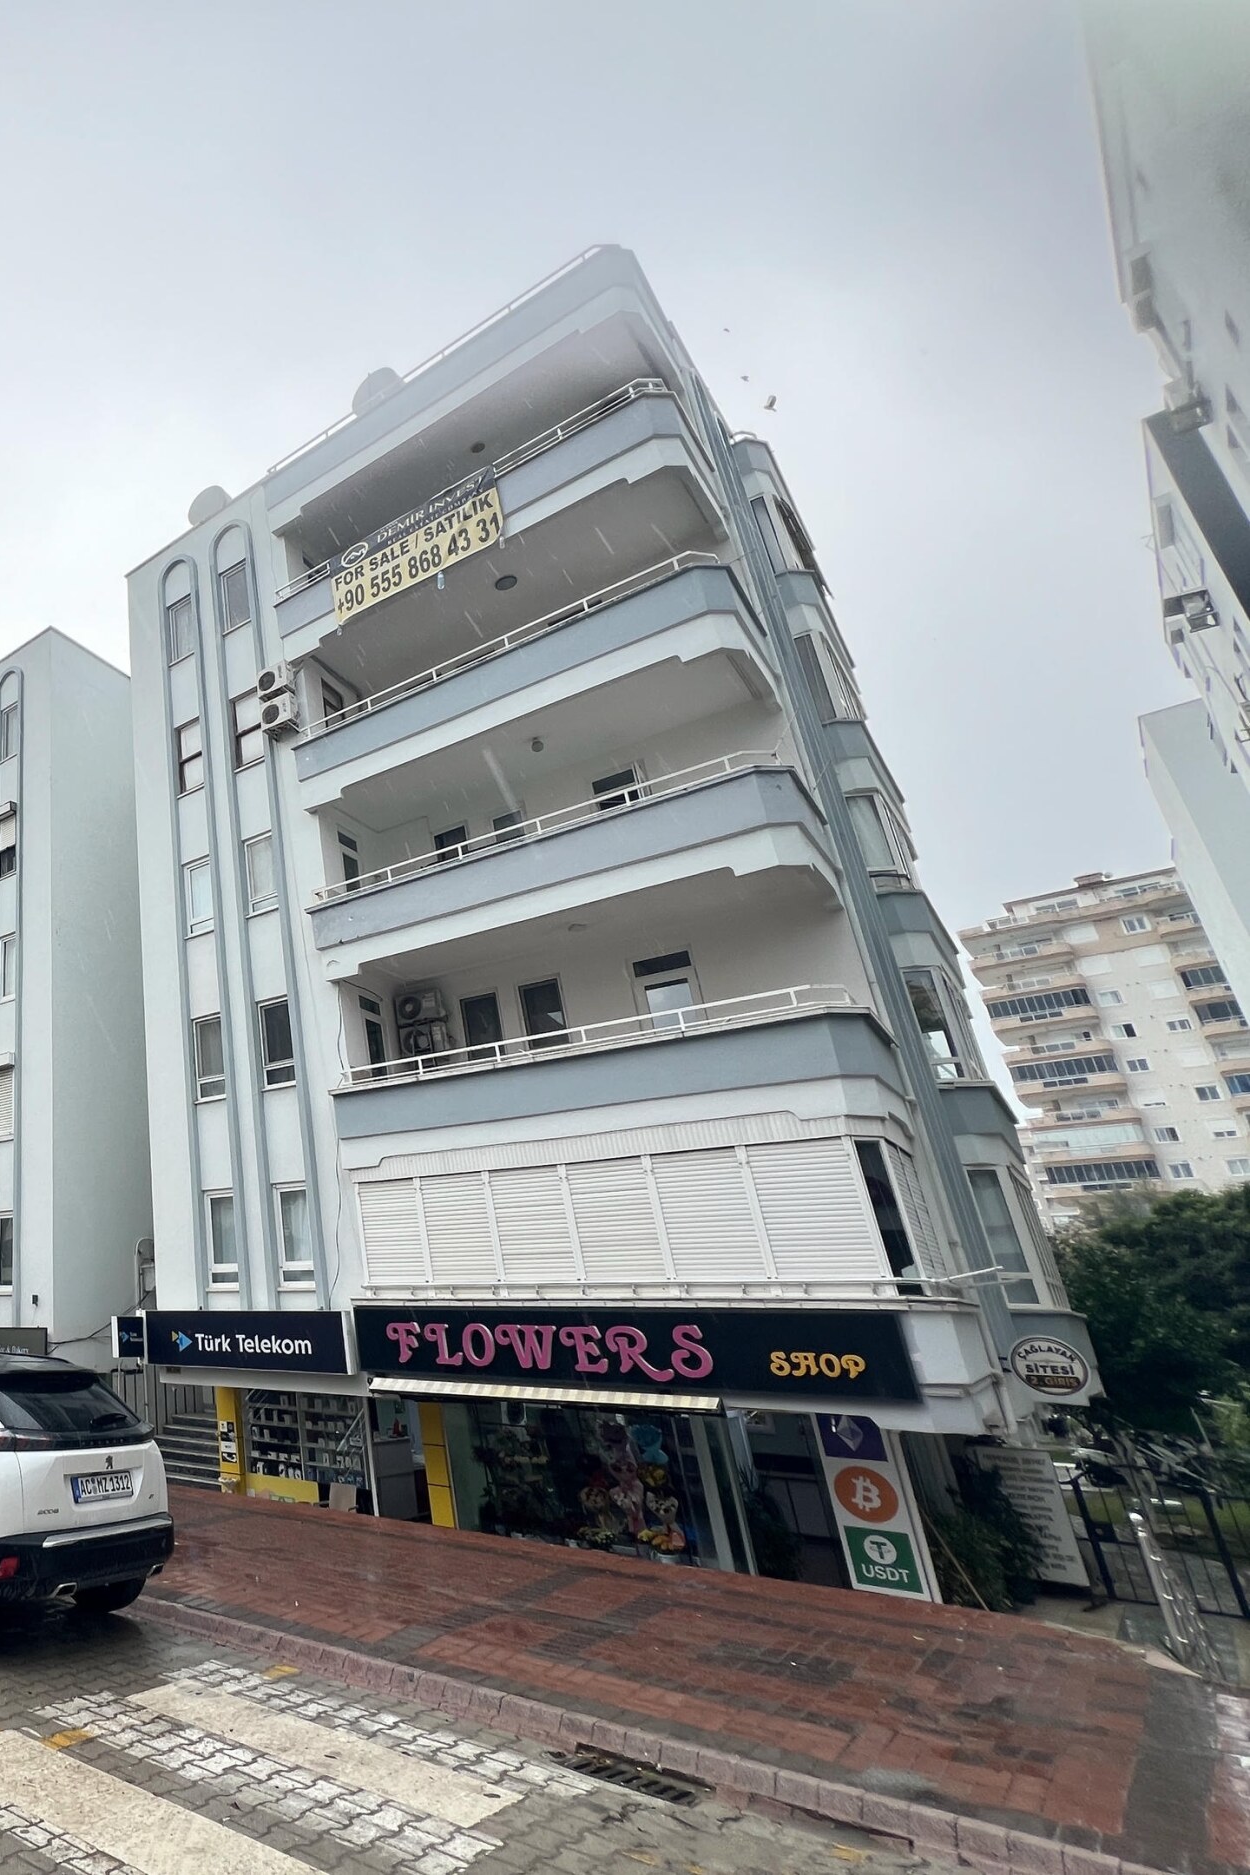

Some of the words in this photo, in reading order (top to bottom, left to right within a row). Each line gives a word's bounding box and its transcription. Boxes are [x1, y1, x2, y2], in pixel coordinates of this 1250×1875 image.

[334, 565, 365, 591] FOR
[369, 539, 411, 572] SALE
[423, 493, 494, 543] SATILIK
[337, 583, 365, 615] +90
[370, 564, 403, 599] 555
[407, 544, 442, 580] 868
[447, 528, 471, 557] 43
[475, 511, 501, 544] 31
[194, 1333, 232, 1352] Türk
[235, 1334, 313, 1356] Telekom
[385, 1321, 715, 1382] FLOWERS
[770, 1350, 867, 1379] SHOP
[1025, 1363, 1075, 1376] SİTESİ
[80, 1479, 92, 1496] AC
[110, 1474, 131, 1492] 1312
[861, 1563, 910, 1584] USDT
